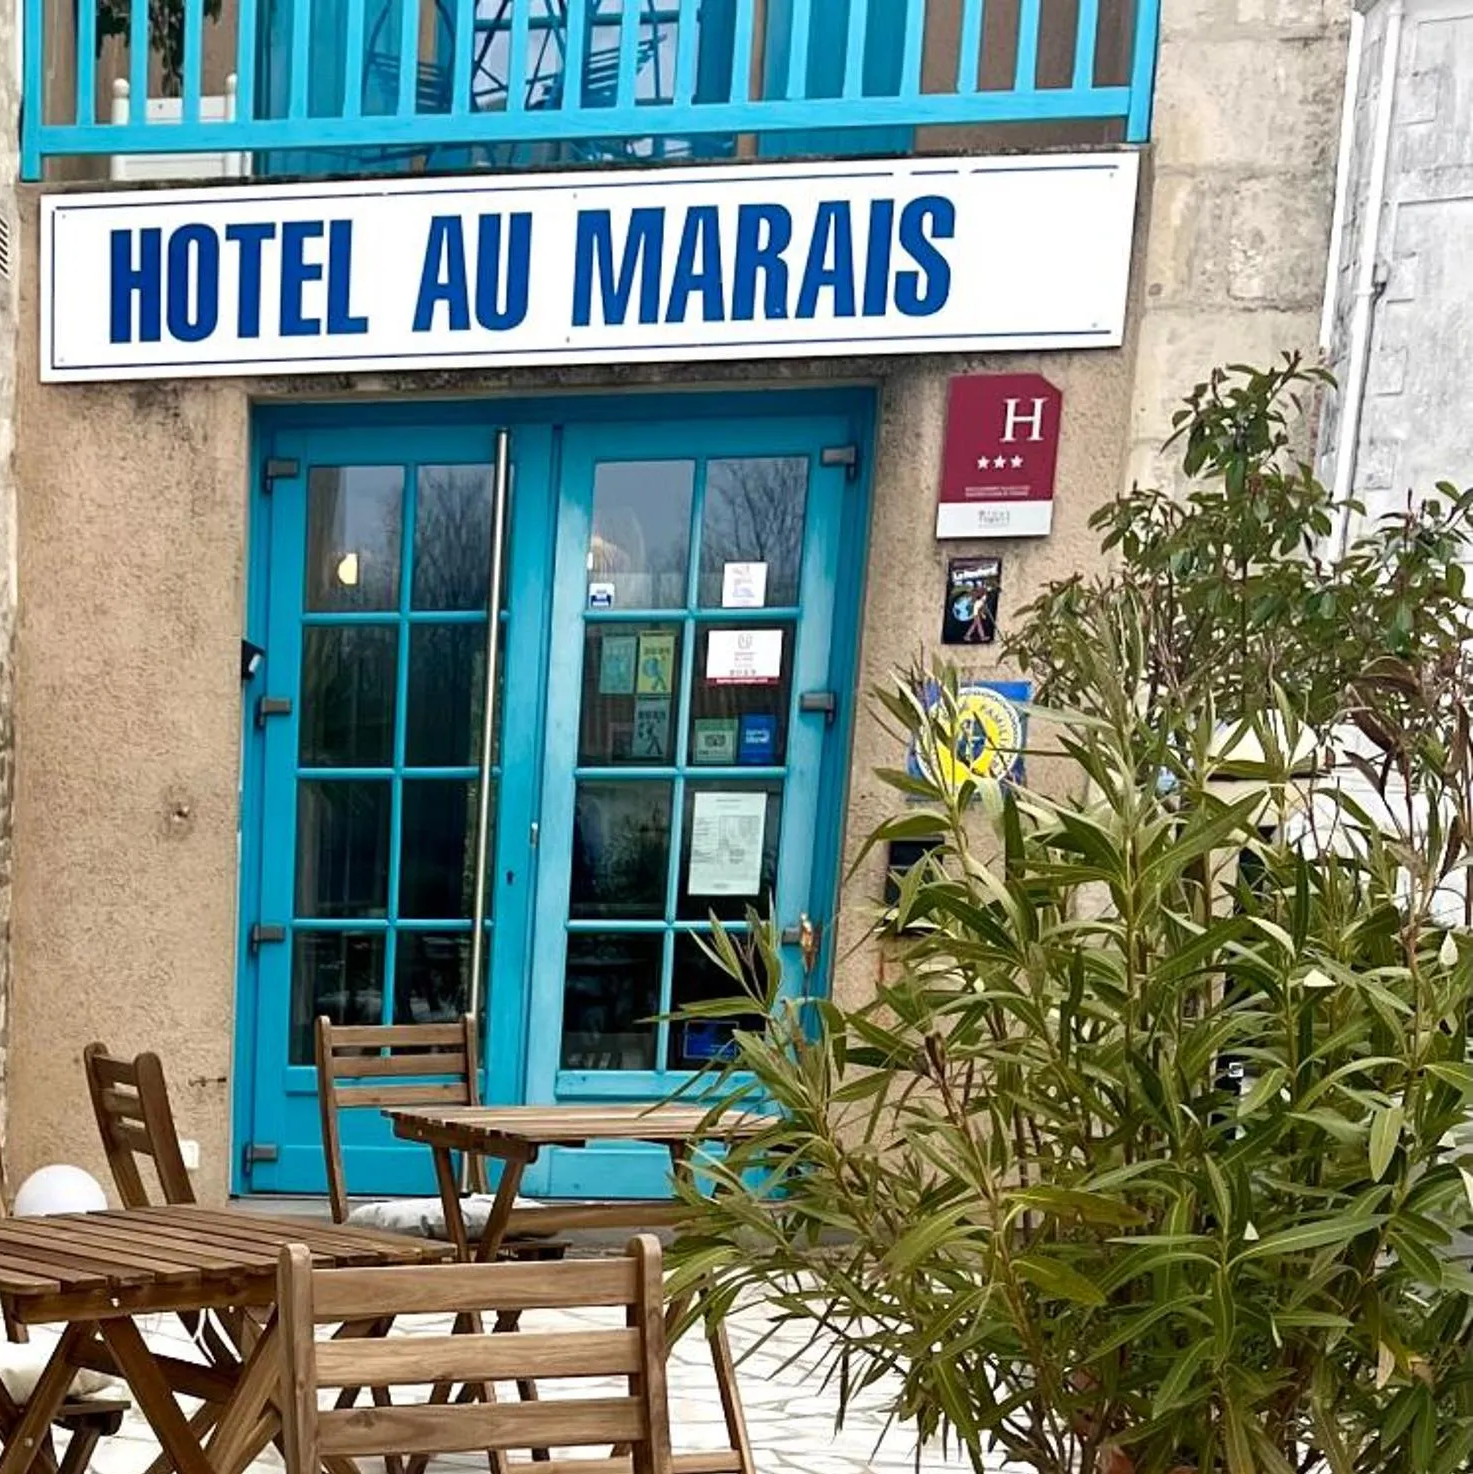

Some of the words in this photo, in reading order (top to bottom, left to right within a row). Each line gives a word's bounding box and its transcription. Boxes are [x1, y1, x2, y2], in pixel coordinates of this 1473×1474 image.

[109, 219, 369, 344] HOTEL
[411, 211, 533, 333] AU
[571, 194, 956, 327] MARAIS
[1000, 397, 1048, 442] H
